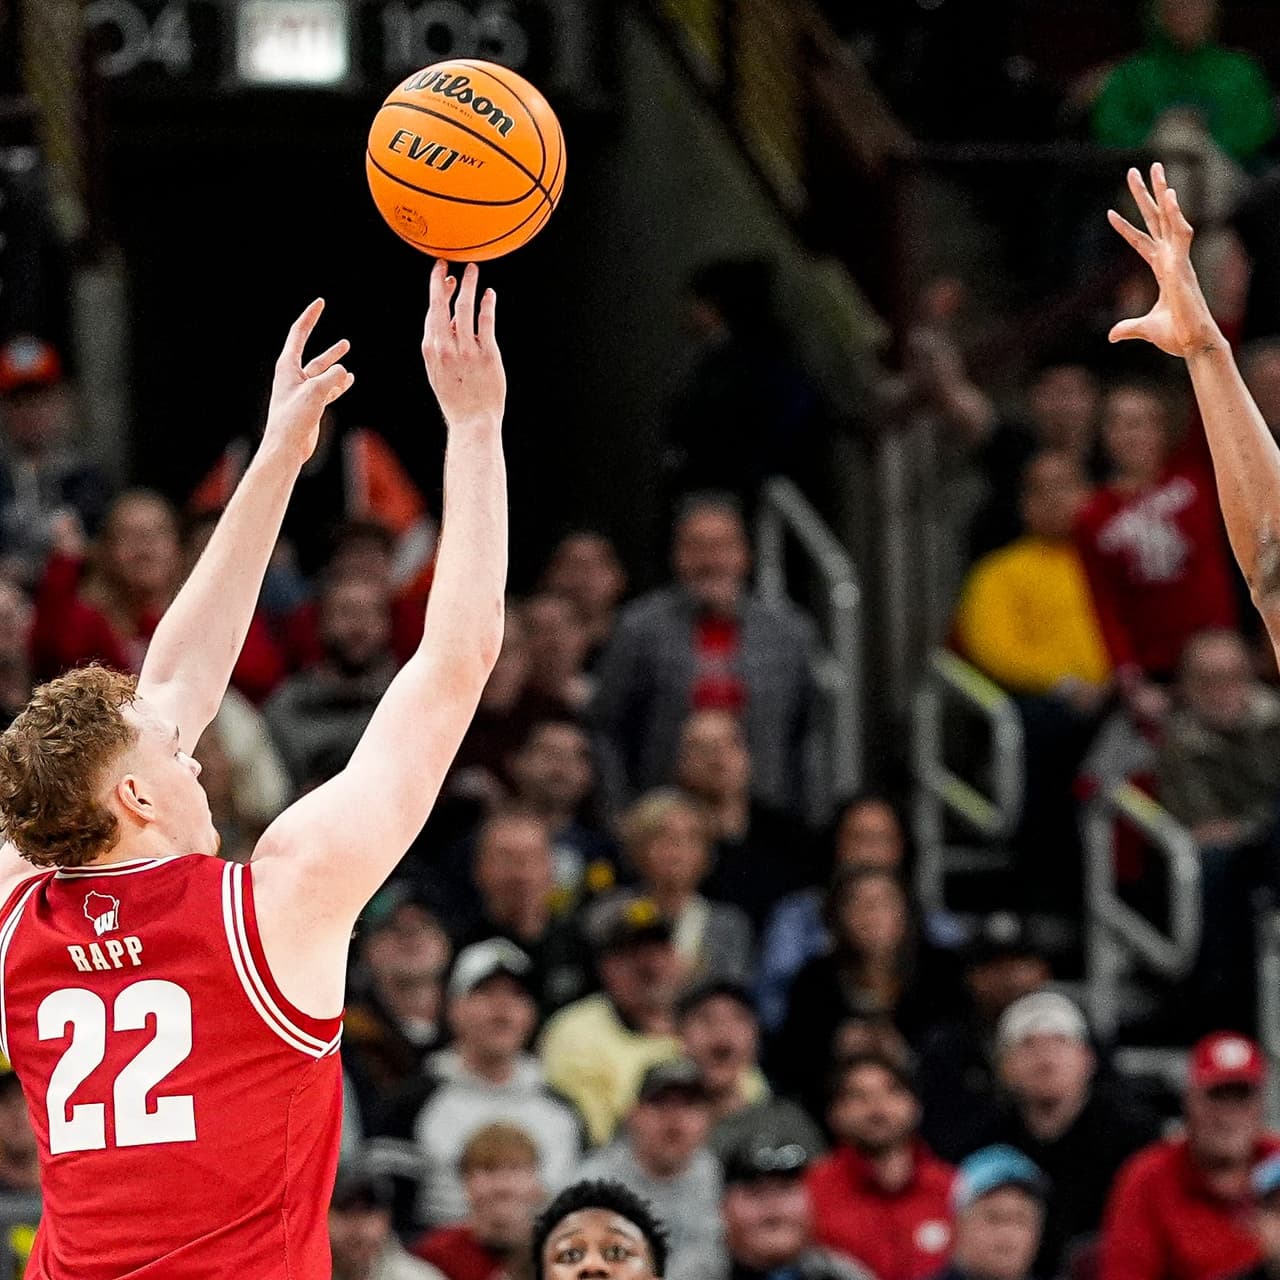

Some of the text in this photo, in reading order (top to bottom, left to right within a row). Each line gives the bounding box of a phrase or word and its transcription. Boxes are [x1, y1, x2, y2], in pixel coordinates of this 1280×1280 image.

[404, 70, 515, 138] Wilson
[459, 154, 487, 169] NXT
[66, 935, 144, 973] RAPP
[36, 978, 198, 1156] 22
